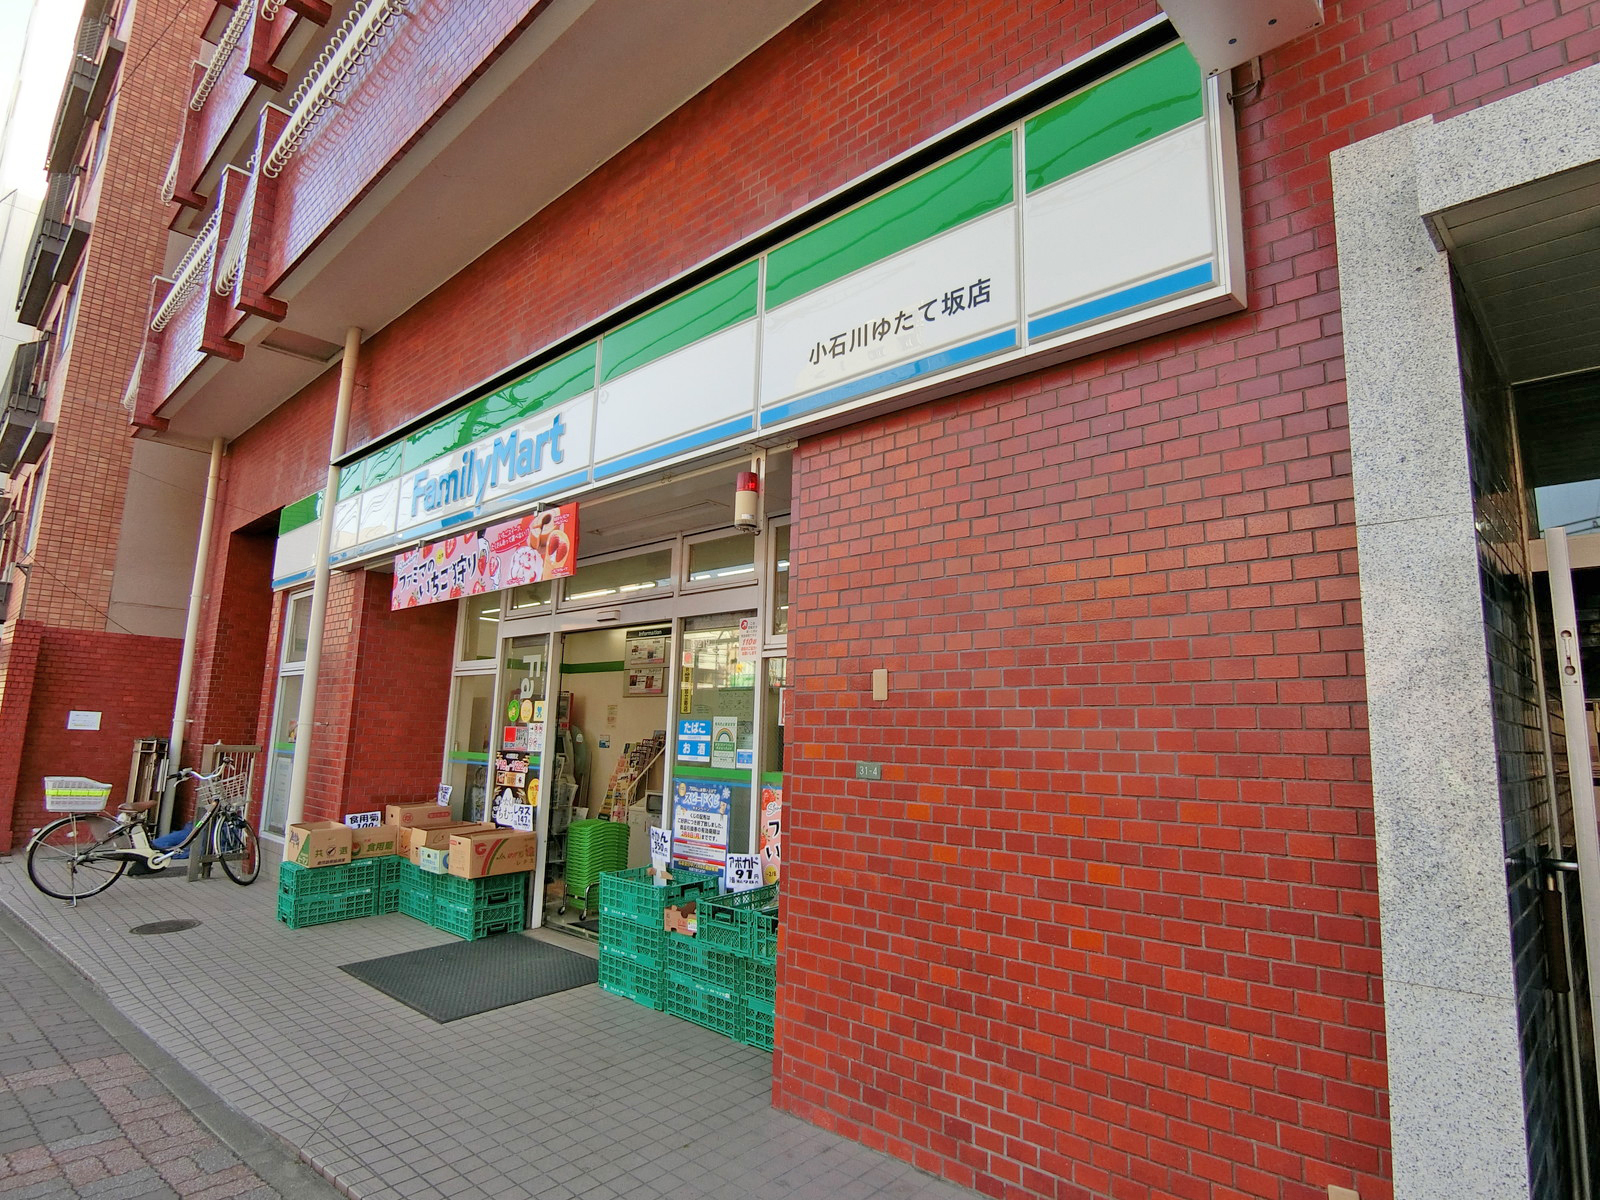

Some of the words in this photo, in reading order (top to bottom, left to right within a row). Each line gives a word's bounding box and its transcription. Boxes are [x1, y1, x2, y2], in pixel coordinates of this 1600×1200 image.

[809, 278, 991, 365] 小石川ゆたて坂店
[411, 413, 566, 518] FamilyMart
[399, 559, 435, 590] ファミマの
[419, 553, 477, 598] いちご狩り
[683, 722, 706, 734] たばこ
[859, 766, 878, 776] 31-4
[683, 792, 720, 809] スピードくじ
[514, 806, 531, 816] レタス
[349, 814, 379, 824] 食用菊
[367, 841, 393, 852] 食用菊
[729, 856, 759, 869] アボカド
